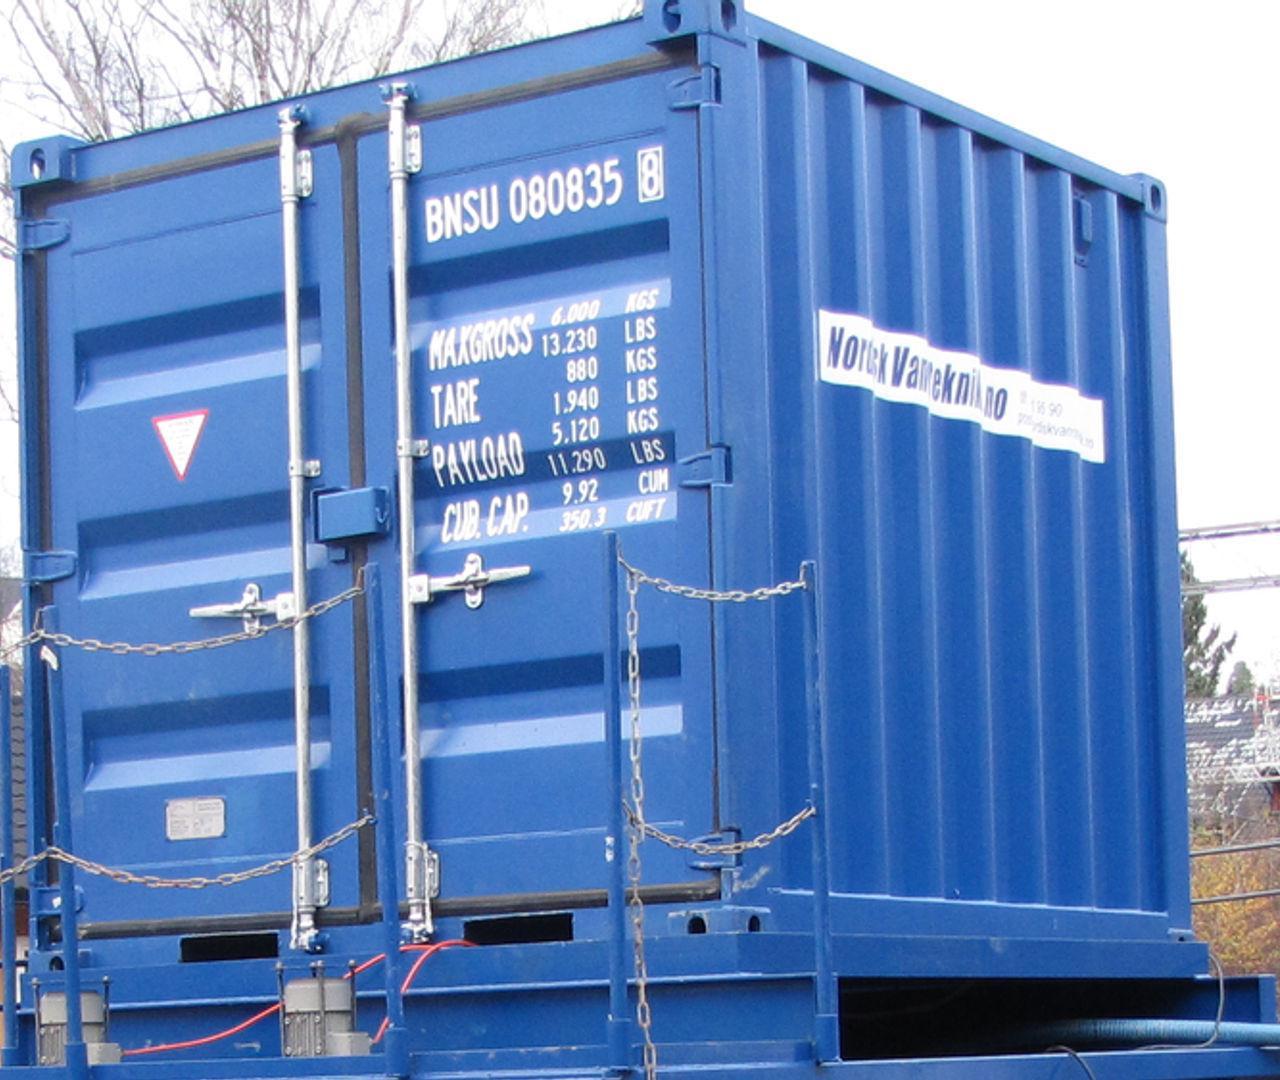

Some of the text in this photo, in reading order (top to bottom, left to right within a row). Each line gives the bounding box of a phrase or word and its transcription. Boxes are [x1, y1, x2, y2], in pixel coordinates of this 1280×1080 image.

[425, 149, 662, 243] BNSU 080835 8
[429, 289, 660, 370] MAXGROSS 6.000 KGS
[542, 317, 657, 357] 13.230 LBS
[430, 347, 657, 429] TARE 880 KGS
[552, 378, 658, 414] 1.940 LBS
[432, 408, 659, 487] PAYLOAD 5.120 KGS
[548, 439, 665, 476] 11.290 LBS
[441, 468, 669, 544] CUB. CAP. 9.92 CUM
[558, 498, 667, 532] 350.3 CUFT
